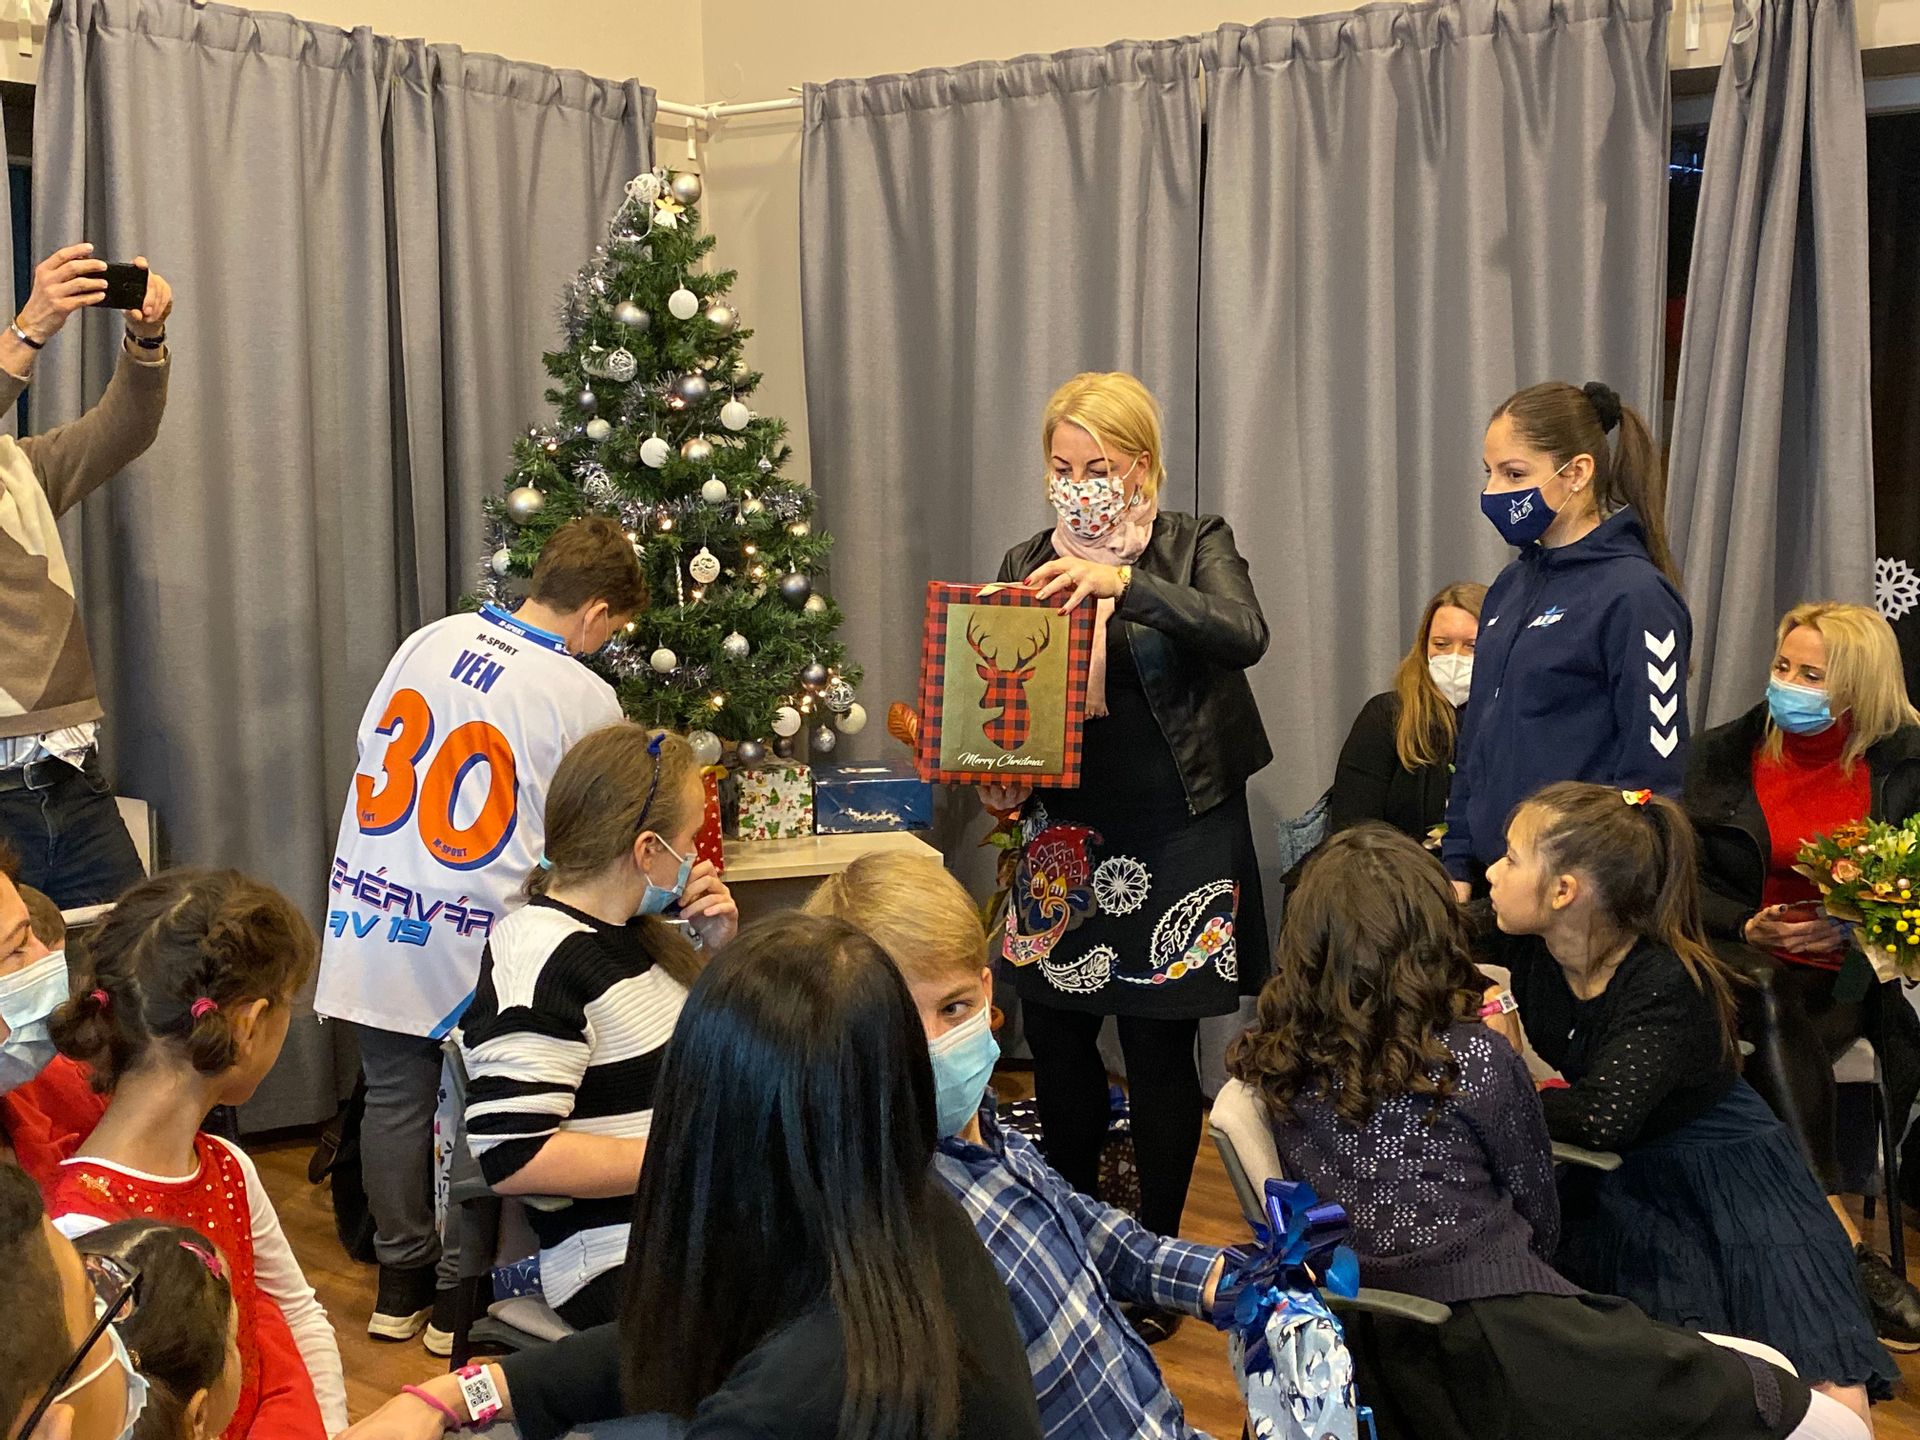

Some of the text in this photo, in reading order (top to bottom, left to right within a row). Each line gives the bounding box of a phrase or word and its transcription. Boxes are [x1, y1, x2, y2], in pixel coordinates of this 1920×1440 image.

[476, 633, 519, 656] M-SPORT
[449, 649, 506, 695] VÉN
[958, 752, 1046, 770] Merry Christmas
[356, 688, 519, 872] 30
[432, 838, 467, 857] M-SPORT
[331, 856, 498, 938] EHÉRVÁR
